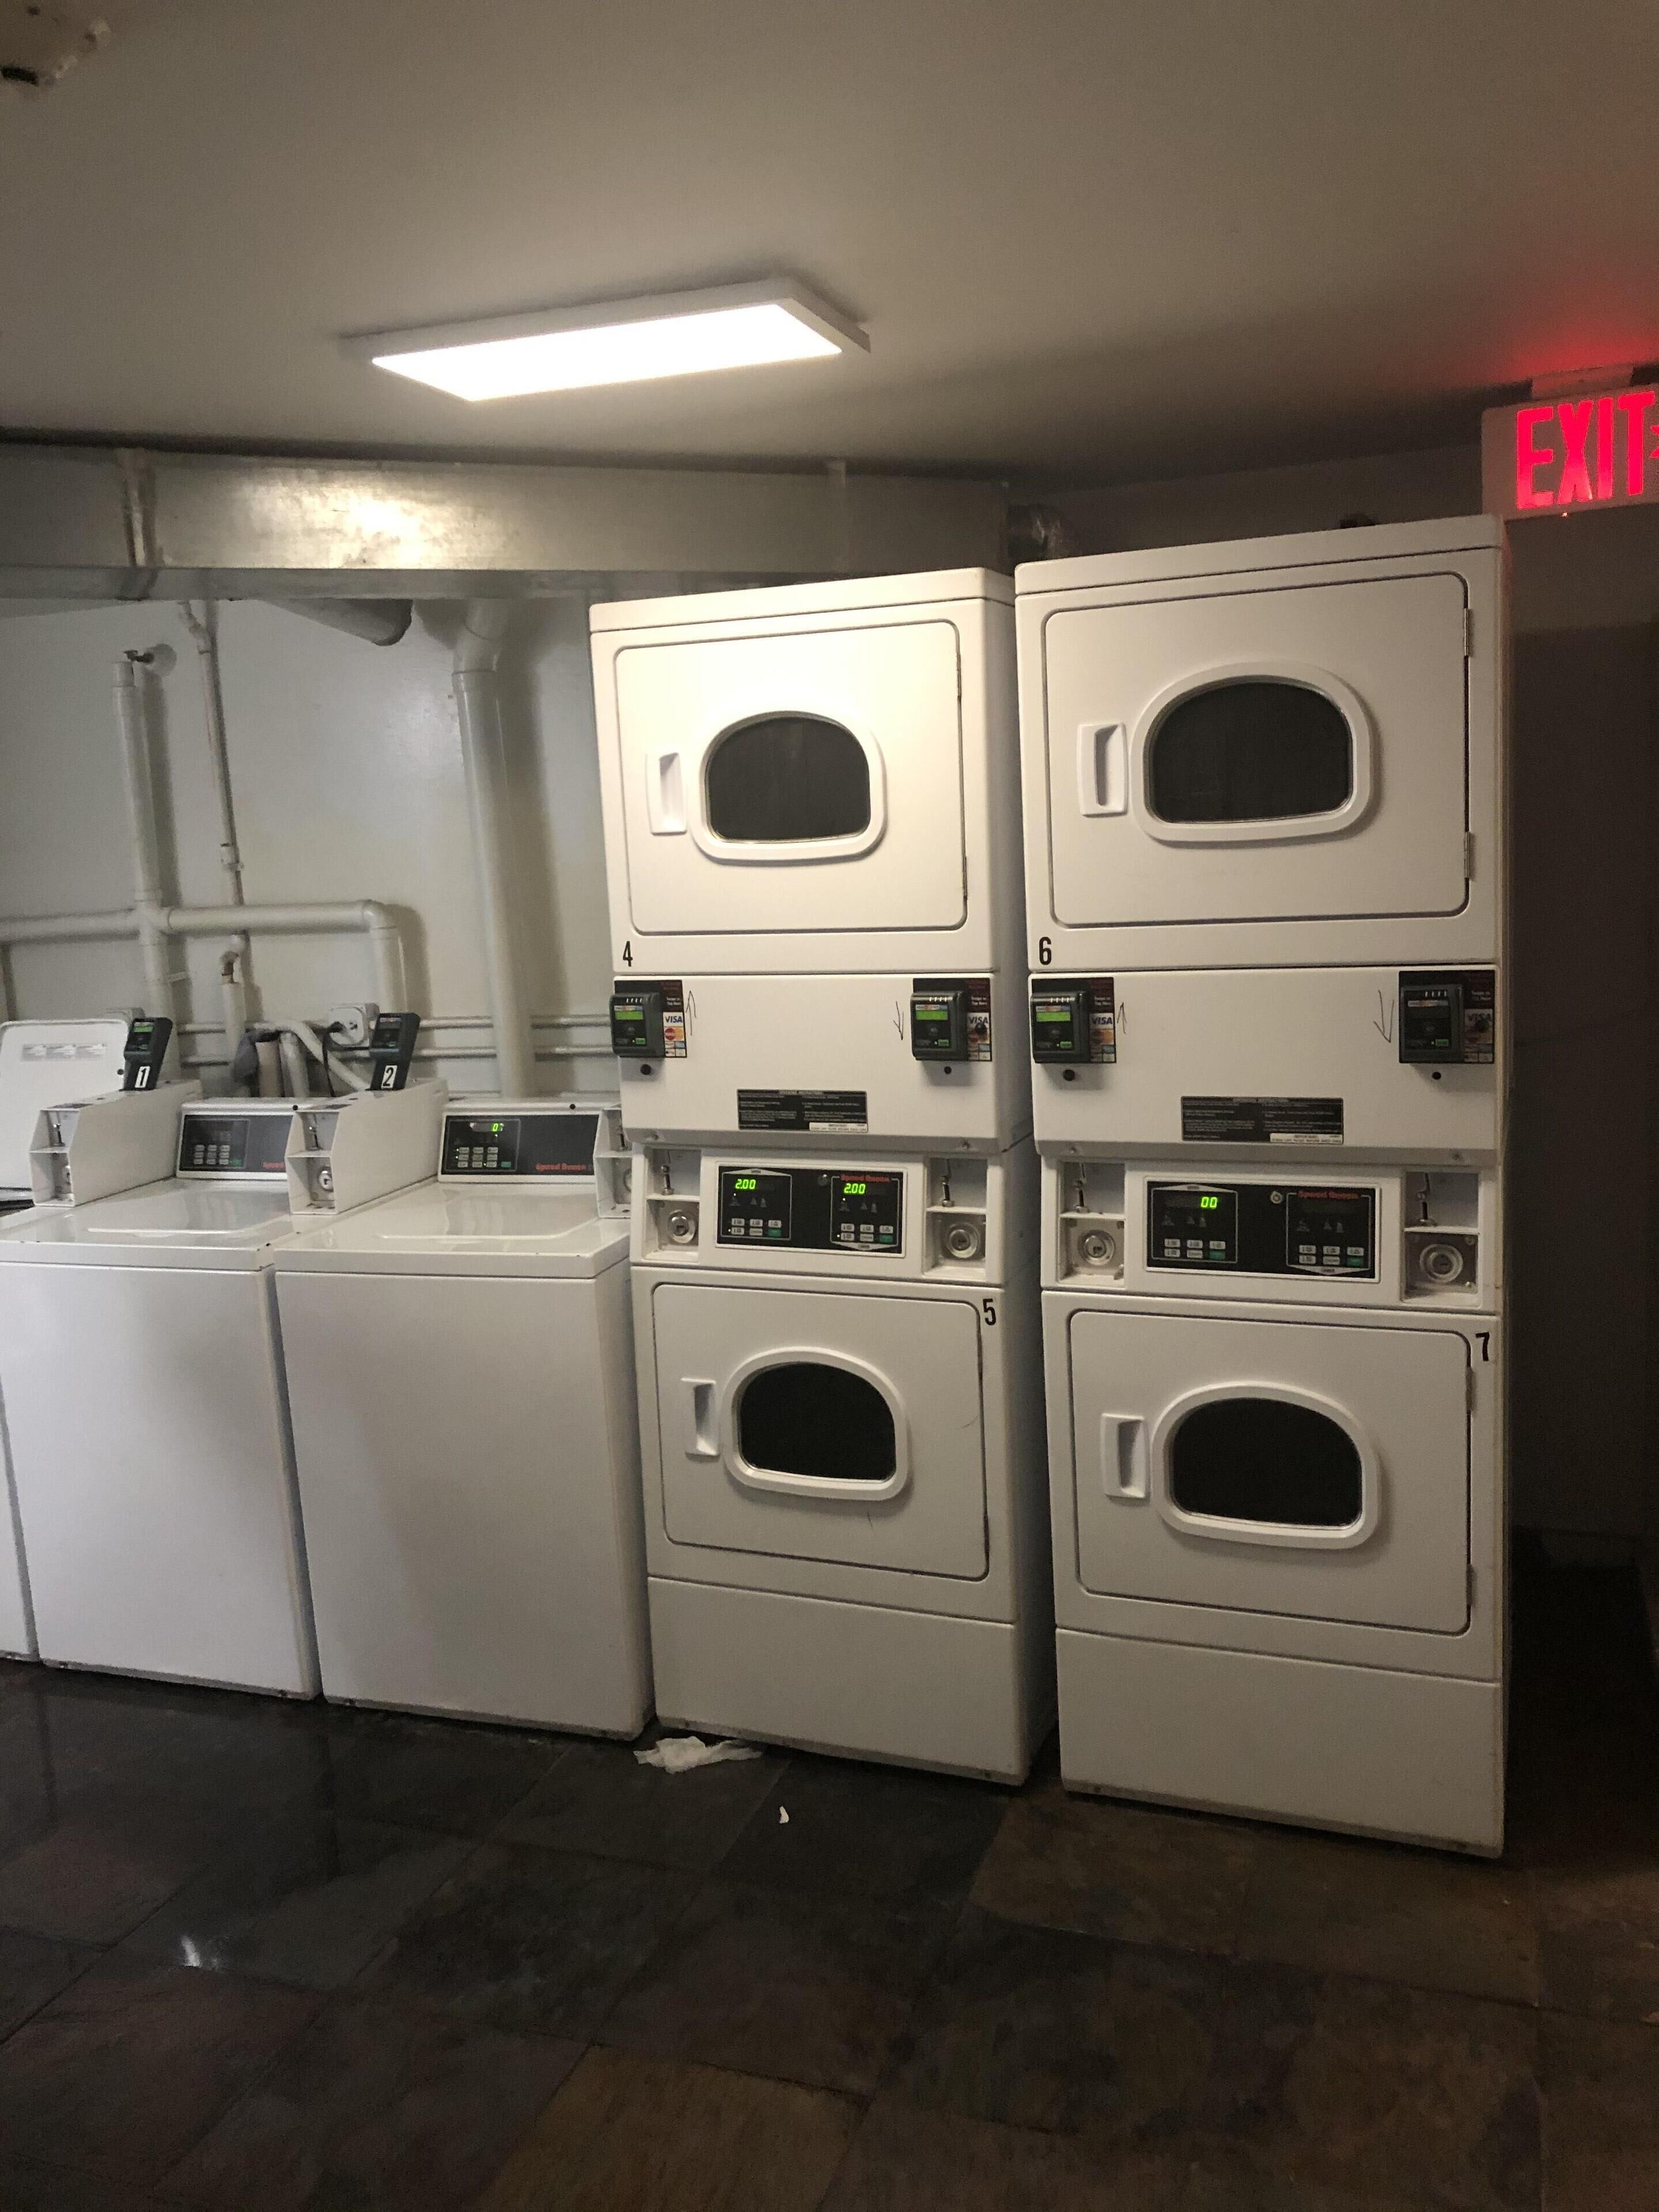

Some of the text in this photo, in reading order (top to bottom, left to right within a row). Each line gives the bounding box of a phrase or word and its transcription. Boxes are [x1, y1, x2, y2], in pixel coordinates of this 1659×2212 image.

[1517, 391, 1655, 510] EXIT
[623, 941, 633, 967] 4
[1039, 937, 1052, 965] 6
[141, 1068, 147, 1086] 1
[382, 1067, 394, 1086] 2
[735, 1179, 756, 1190] 2.00
[844, 1183, 866, 1194] 2.00
[1200, 1196, 1217, 1208] 00
[982, 1298, 997, 1326] 5
[1475, 1331, 1490, 1362] 7
